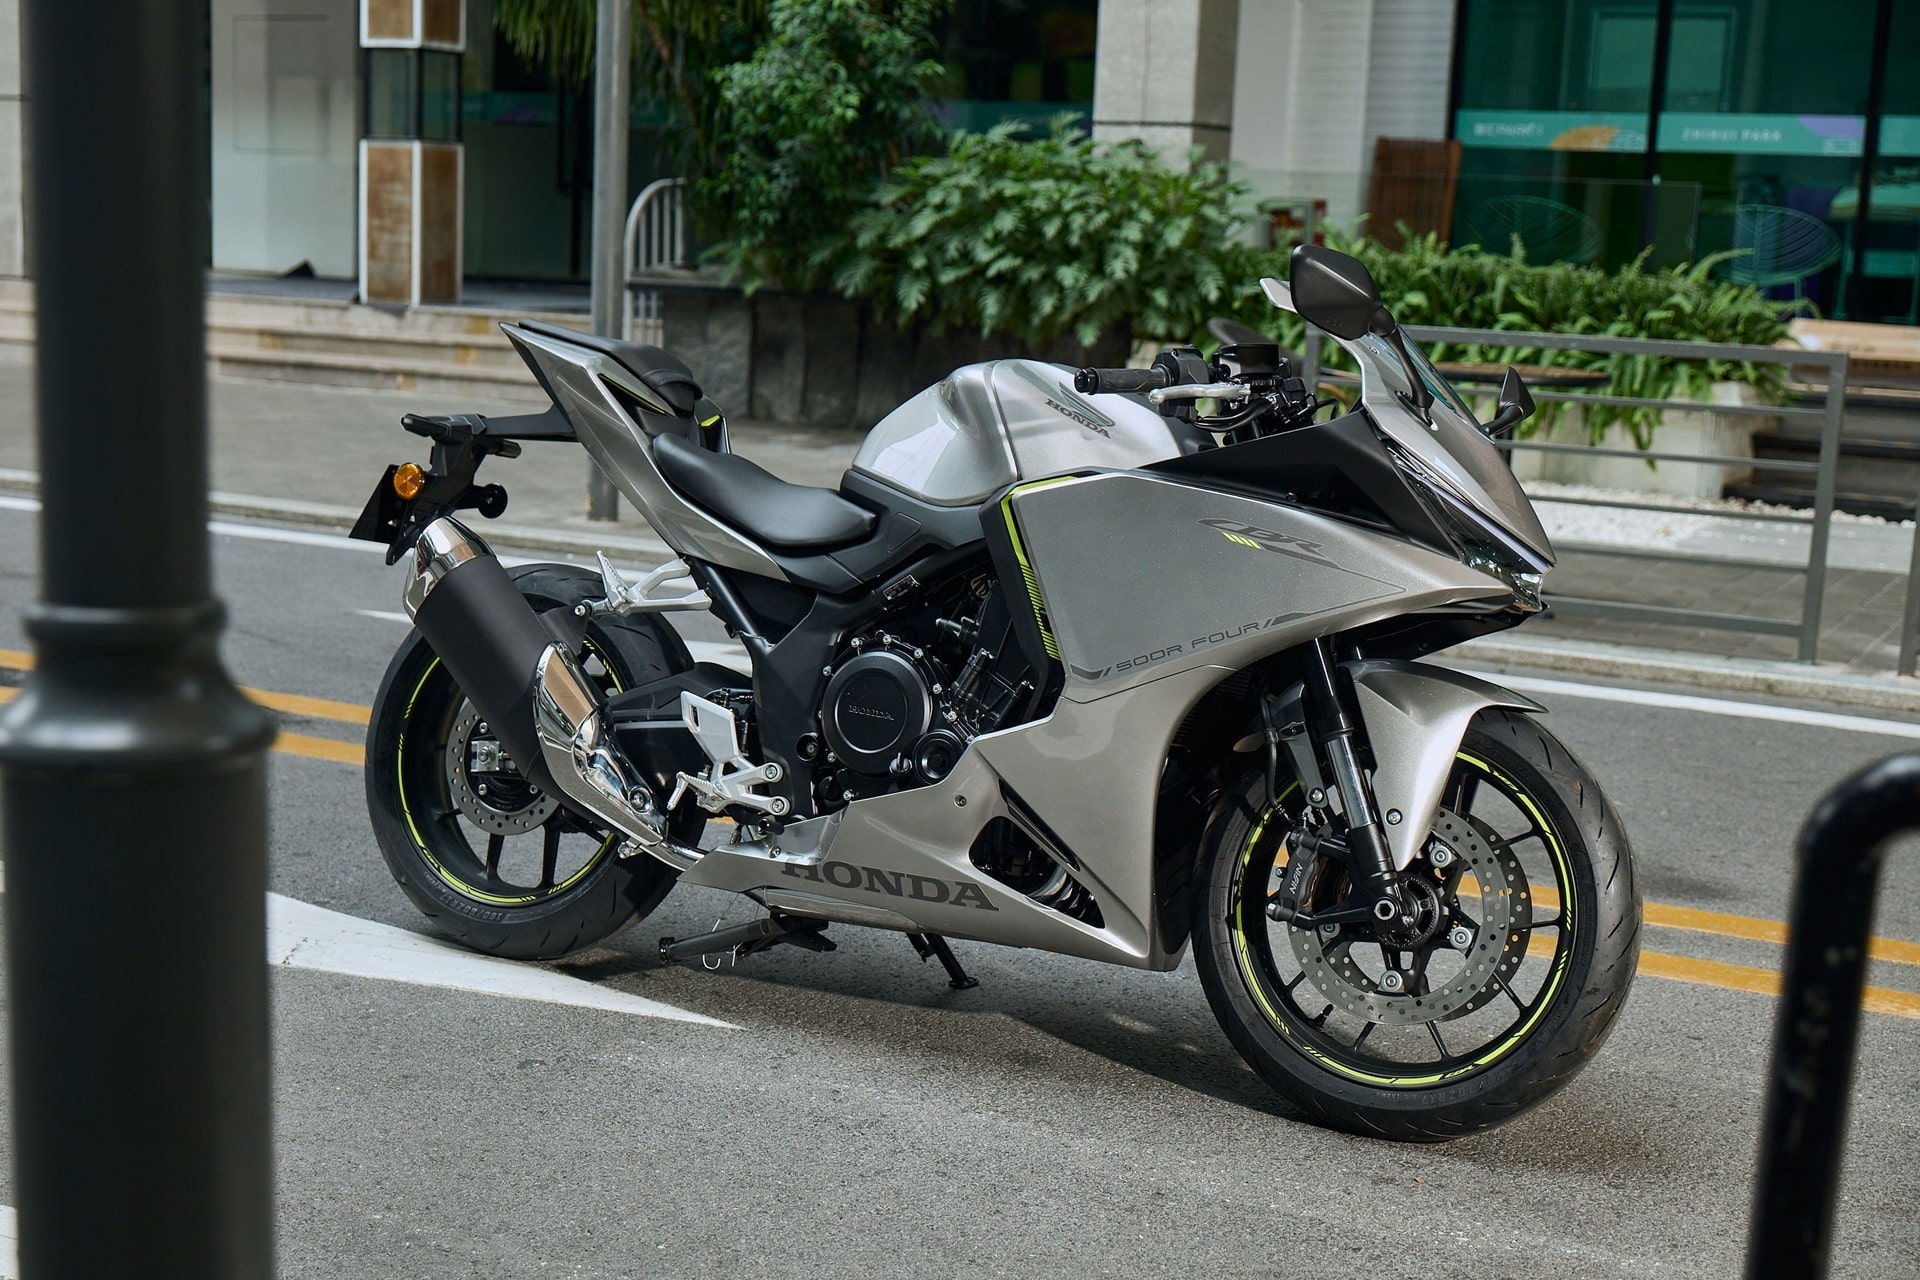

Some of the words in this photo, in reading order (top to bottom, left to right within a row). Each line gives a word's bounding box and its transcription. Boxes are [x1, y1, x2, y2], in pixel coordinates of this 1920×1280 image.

[1045, 398, 1111, 439] HONDA
[1116, 644, 1183, 673] 500R
[1191, 622, 1261, 650] FOUR
[848, 705, 895, 721] HONDA
[781, 860, 1000, 912] HONDA
